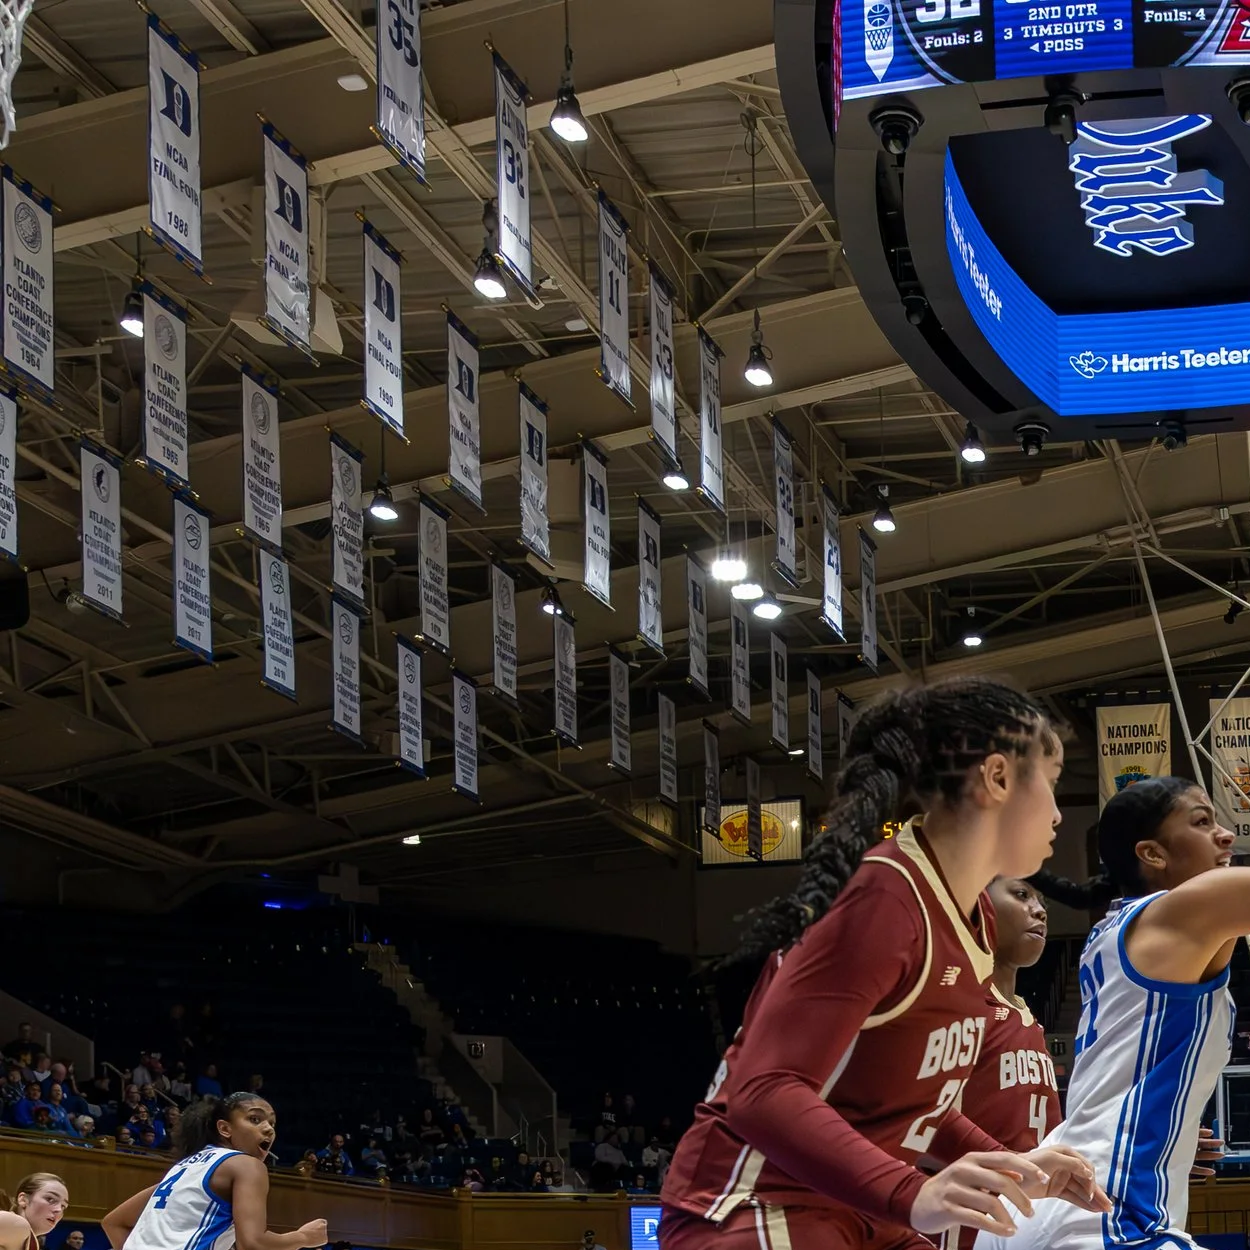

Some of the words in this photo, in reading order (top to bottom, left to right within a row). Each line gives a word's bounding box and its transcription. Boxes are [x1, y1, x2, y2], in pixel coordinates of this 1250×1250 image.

[1028, 8, 1062, 22] 2ND
[1065, 4, 1098, 19] QTR
[1144, 9, 1192, 23] Fouls:
[1195, 7, 1206, 21] 4
[388, 0, 419, 68] 35
[924, 33, 970, 49] Fouls:
[974, 30, 983, 43] 2
[1004, 27, 1013, 41] 3
[1020, 20, 1106, 38] TIMEOUTS
[1113, 18, 1124, 31] 3
[1043, 38, 1085, 53] POSS
[166, 142, 189, 173] NCAA
[153, 158, 179, 190] FINAL
[168, 211, 189, 238] 1988
[279, 240, 300, 266] NCAA
[13, 254, 46, 290] ATLANTIC
[967, 242, 1003, 321] Teeter
[17, 275, 42, 302] COAST
[6, 283, 53, 328] CONFERENCE
[8, 302, 52, 343] CHAMPIONS
[377, 329, 393, 353] NCAA
[21, 347, 42, 372] 1964
[368, 343, 385, 368] FINAL
[1112, 352, 1180, 374] Harris
[152, 362, 181, 392] ATLANTIC
[157, 381, 177, 404] COAST
[378, 386, 394, 408] 1990
[147, 389, 187, 425] CONFERENCE
[149, 405, 186, 439] CHAMPIONS
[1107, 722, 1161, 740] NATIONAL
[1101, 740, 1168, 758] CHAMPIONS
[900, 1077, 970, 1154] 2
[1029, 1094, 1048, 1145] 4
[153, 1167, 188, 1210] 4
